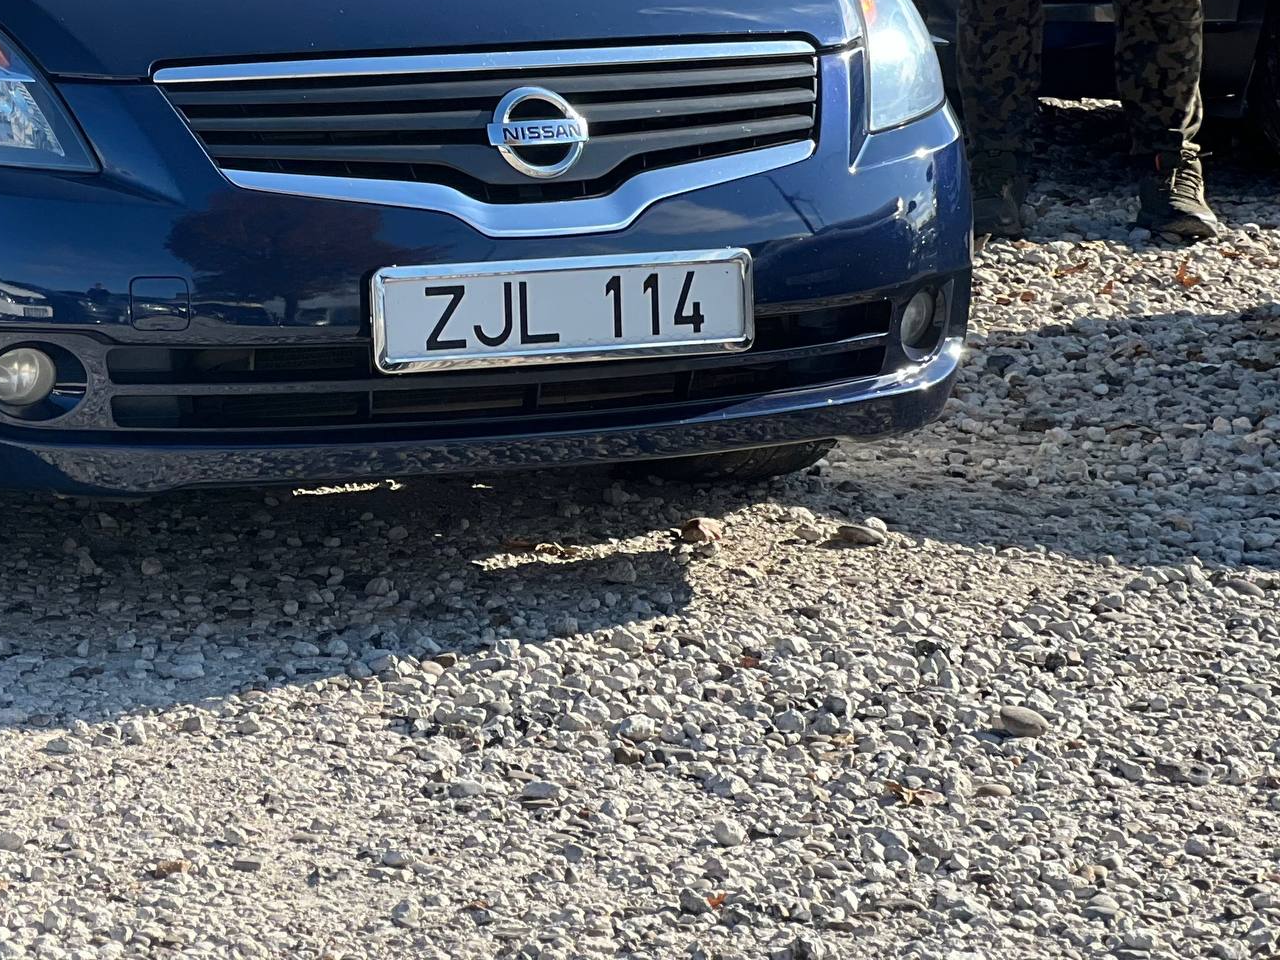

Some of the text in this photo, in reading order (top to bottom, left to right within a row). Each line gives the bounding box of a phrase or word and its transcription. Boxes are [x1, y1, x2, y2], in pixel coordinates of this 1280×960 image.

[502, 123, 582, 141] NISSAN
[424, 270, 705, 351] ZJL 114
